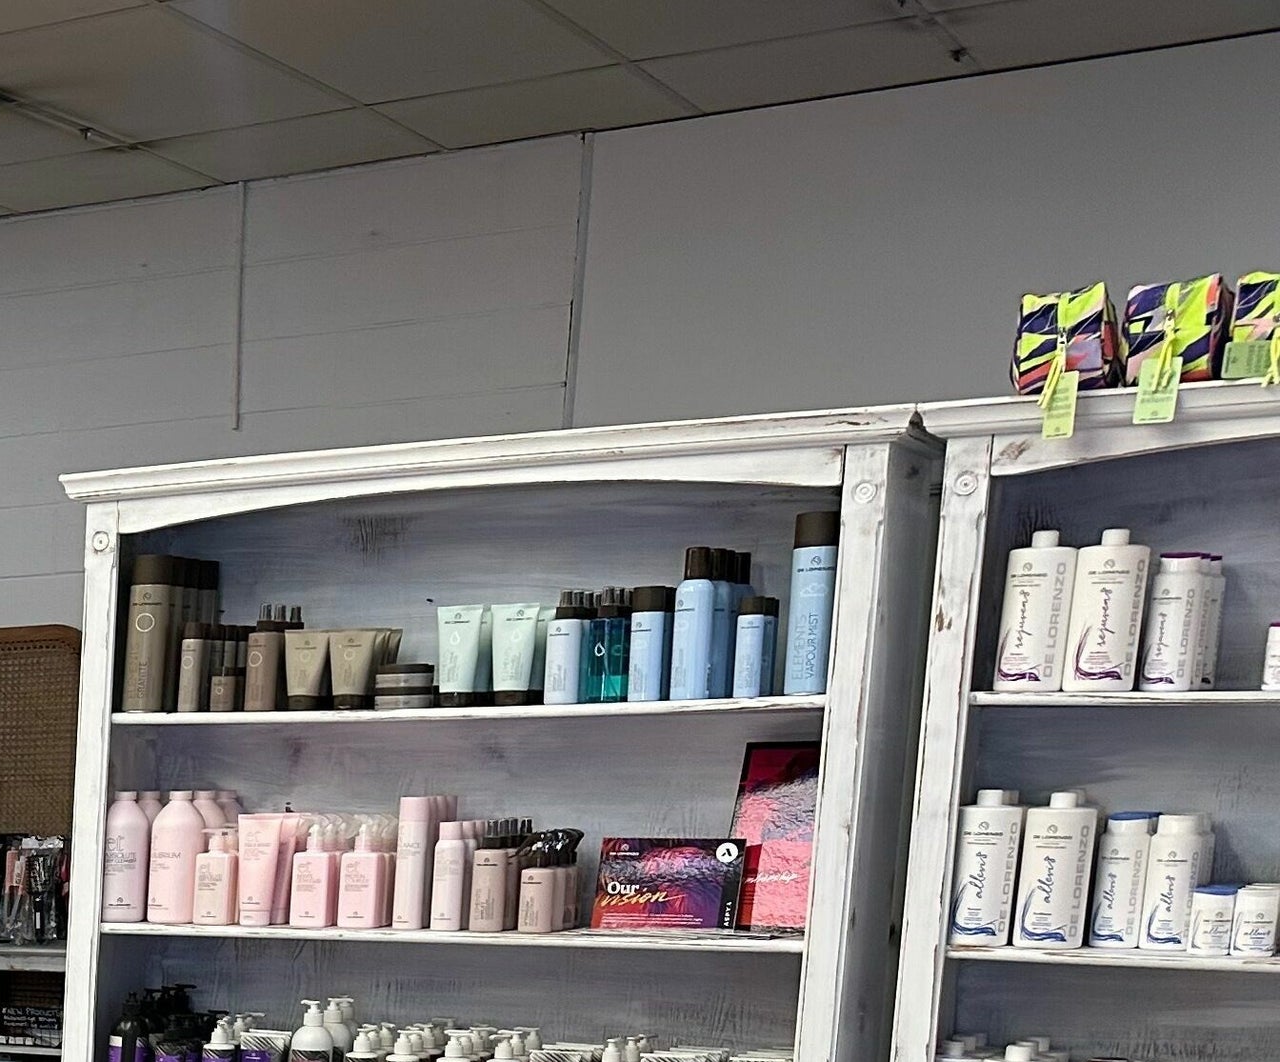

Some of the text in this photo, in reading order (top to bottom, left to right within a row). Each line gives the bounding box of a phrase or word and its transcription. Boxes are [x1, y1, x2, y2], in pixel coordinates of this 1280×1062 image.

[1043, 562, 1067, 679] DE LORENZO
[1122, 559, 1146, 678] DE LORENZO
[1176, 588, 1196, 679] DE LORENZO
[601, 889, 687, 907] vision
[607, 881, 640, 895] Our
[997, 821, 1019, 933] DE LORENZO
[1069, 825, 1090, 938] DE LORENZO
[1125, 848, 1144, 936] DE LORENZO
